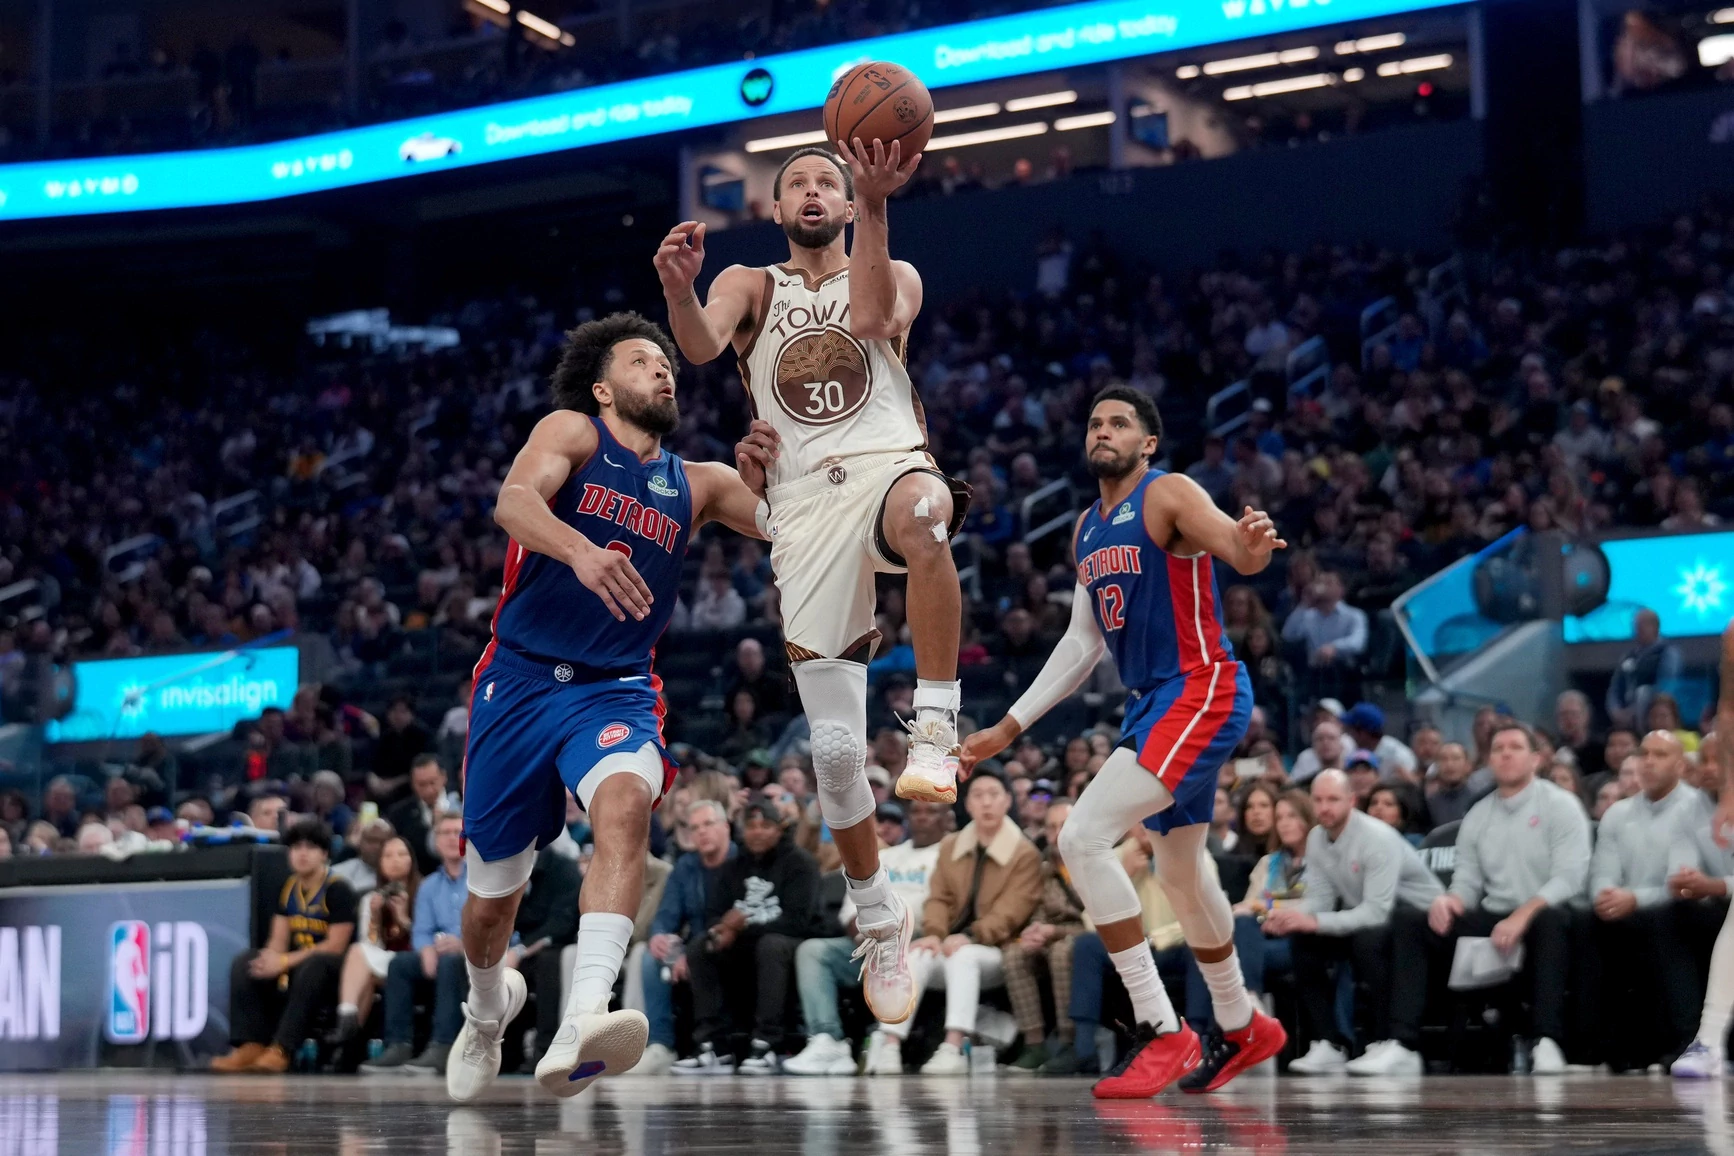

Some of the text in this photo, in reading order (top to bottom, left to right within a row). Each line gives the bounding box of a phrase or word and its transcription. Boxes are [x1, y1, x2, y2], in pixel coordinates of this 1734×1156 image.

[935, 15, 1177, 69] Download and ride today
[485, 96, 691, 146] Download and ride today
[44, 174, 139, 198] WAYMO
[272, 148, 353, 179] WAYMO
[803, 381, 844, 415] 30
[576, 483, 681, 554] DETROIT
[1096, 584, 1125, 631] 12
[161, 675, 277, 708] invisalign
[154, 921, 209, 1041] iD
